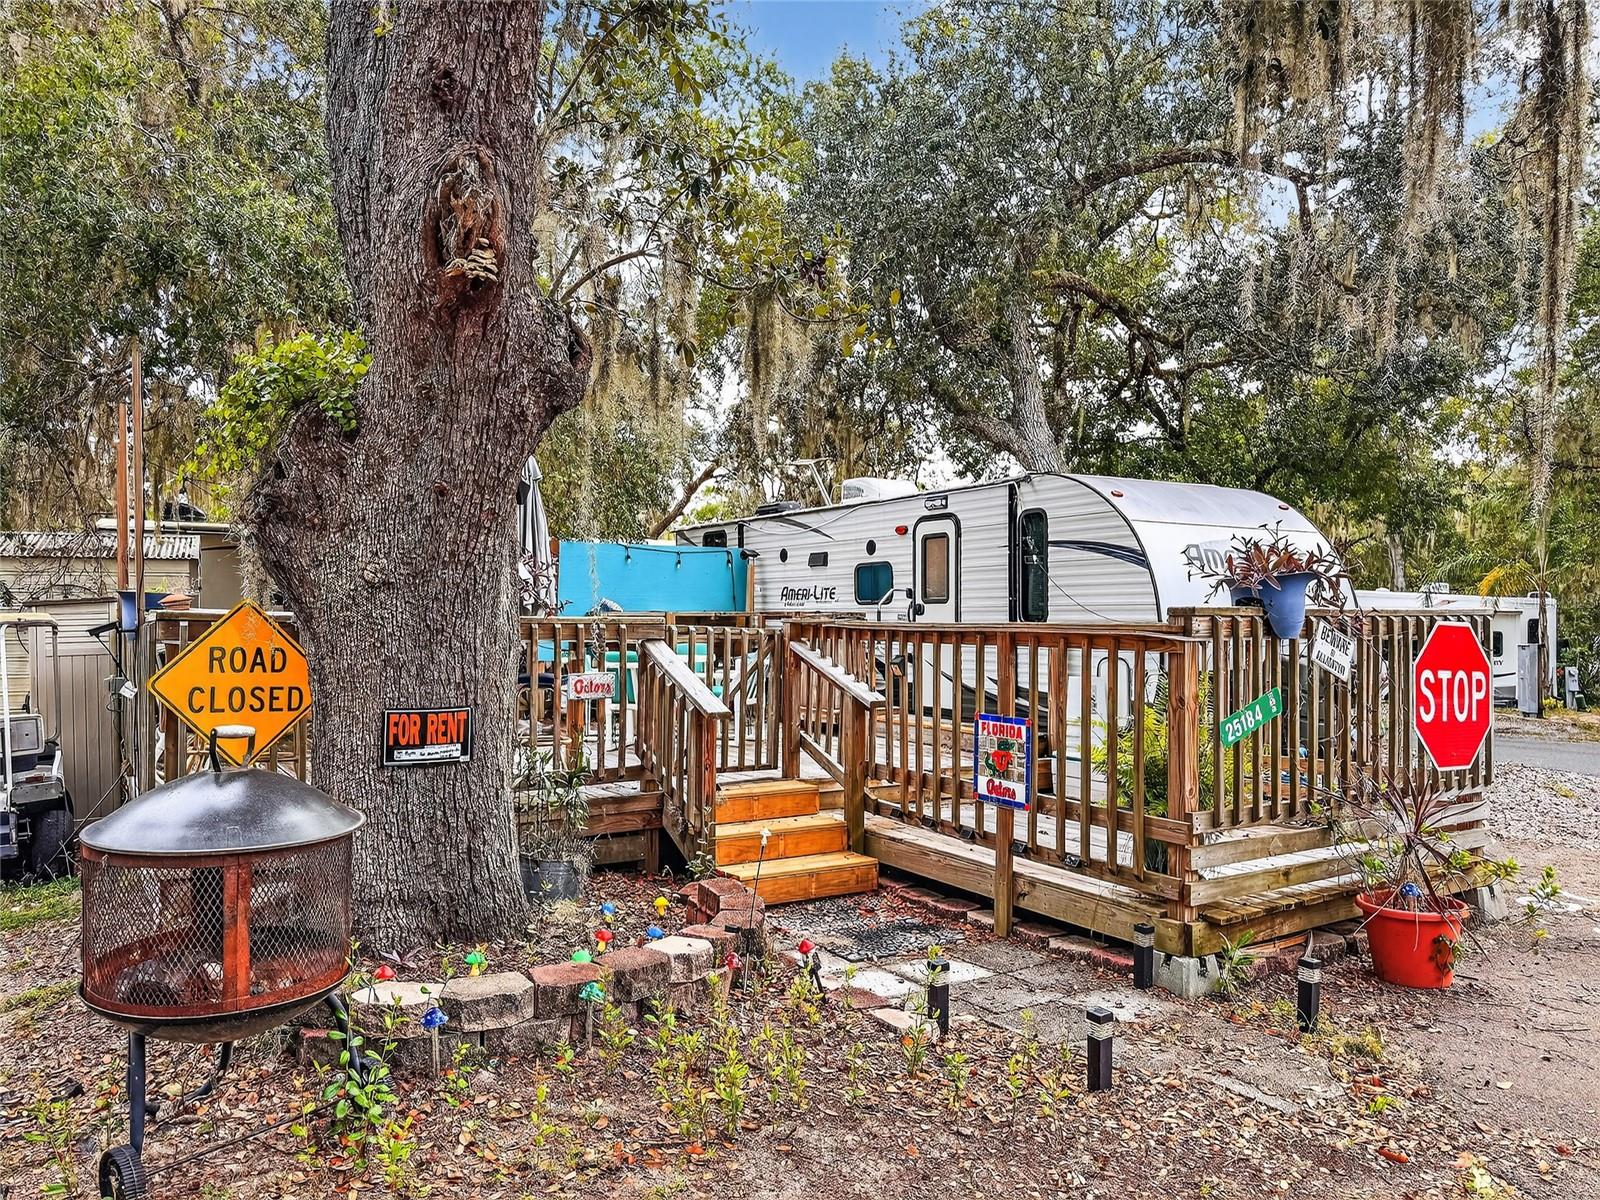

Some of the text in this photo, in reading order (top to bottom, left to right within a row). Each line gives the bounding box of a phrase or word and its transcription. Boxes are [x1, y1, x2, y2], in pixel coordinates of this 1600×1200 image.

[1320, 625, 1352, 657] BEWARE
[208, 646, 288, 674] ROAD
[188, 686, 305, 714] CLOSED
[1419, 669, 1487, 723] STOP
[388, 711, 468, 746] FOR RENT
[981, 721, 1023, 740] FLORIDA
[1225, 703, 1263, 742] 25184
